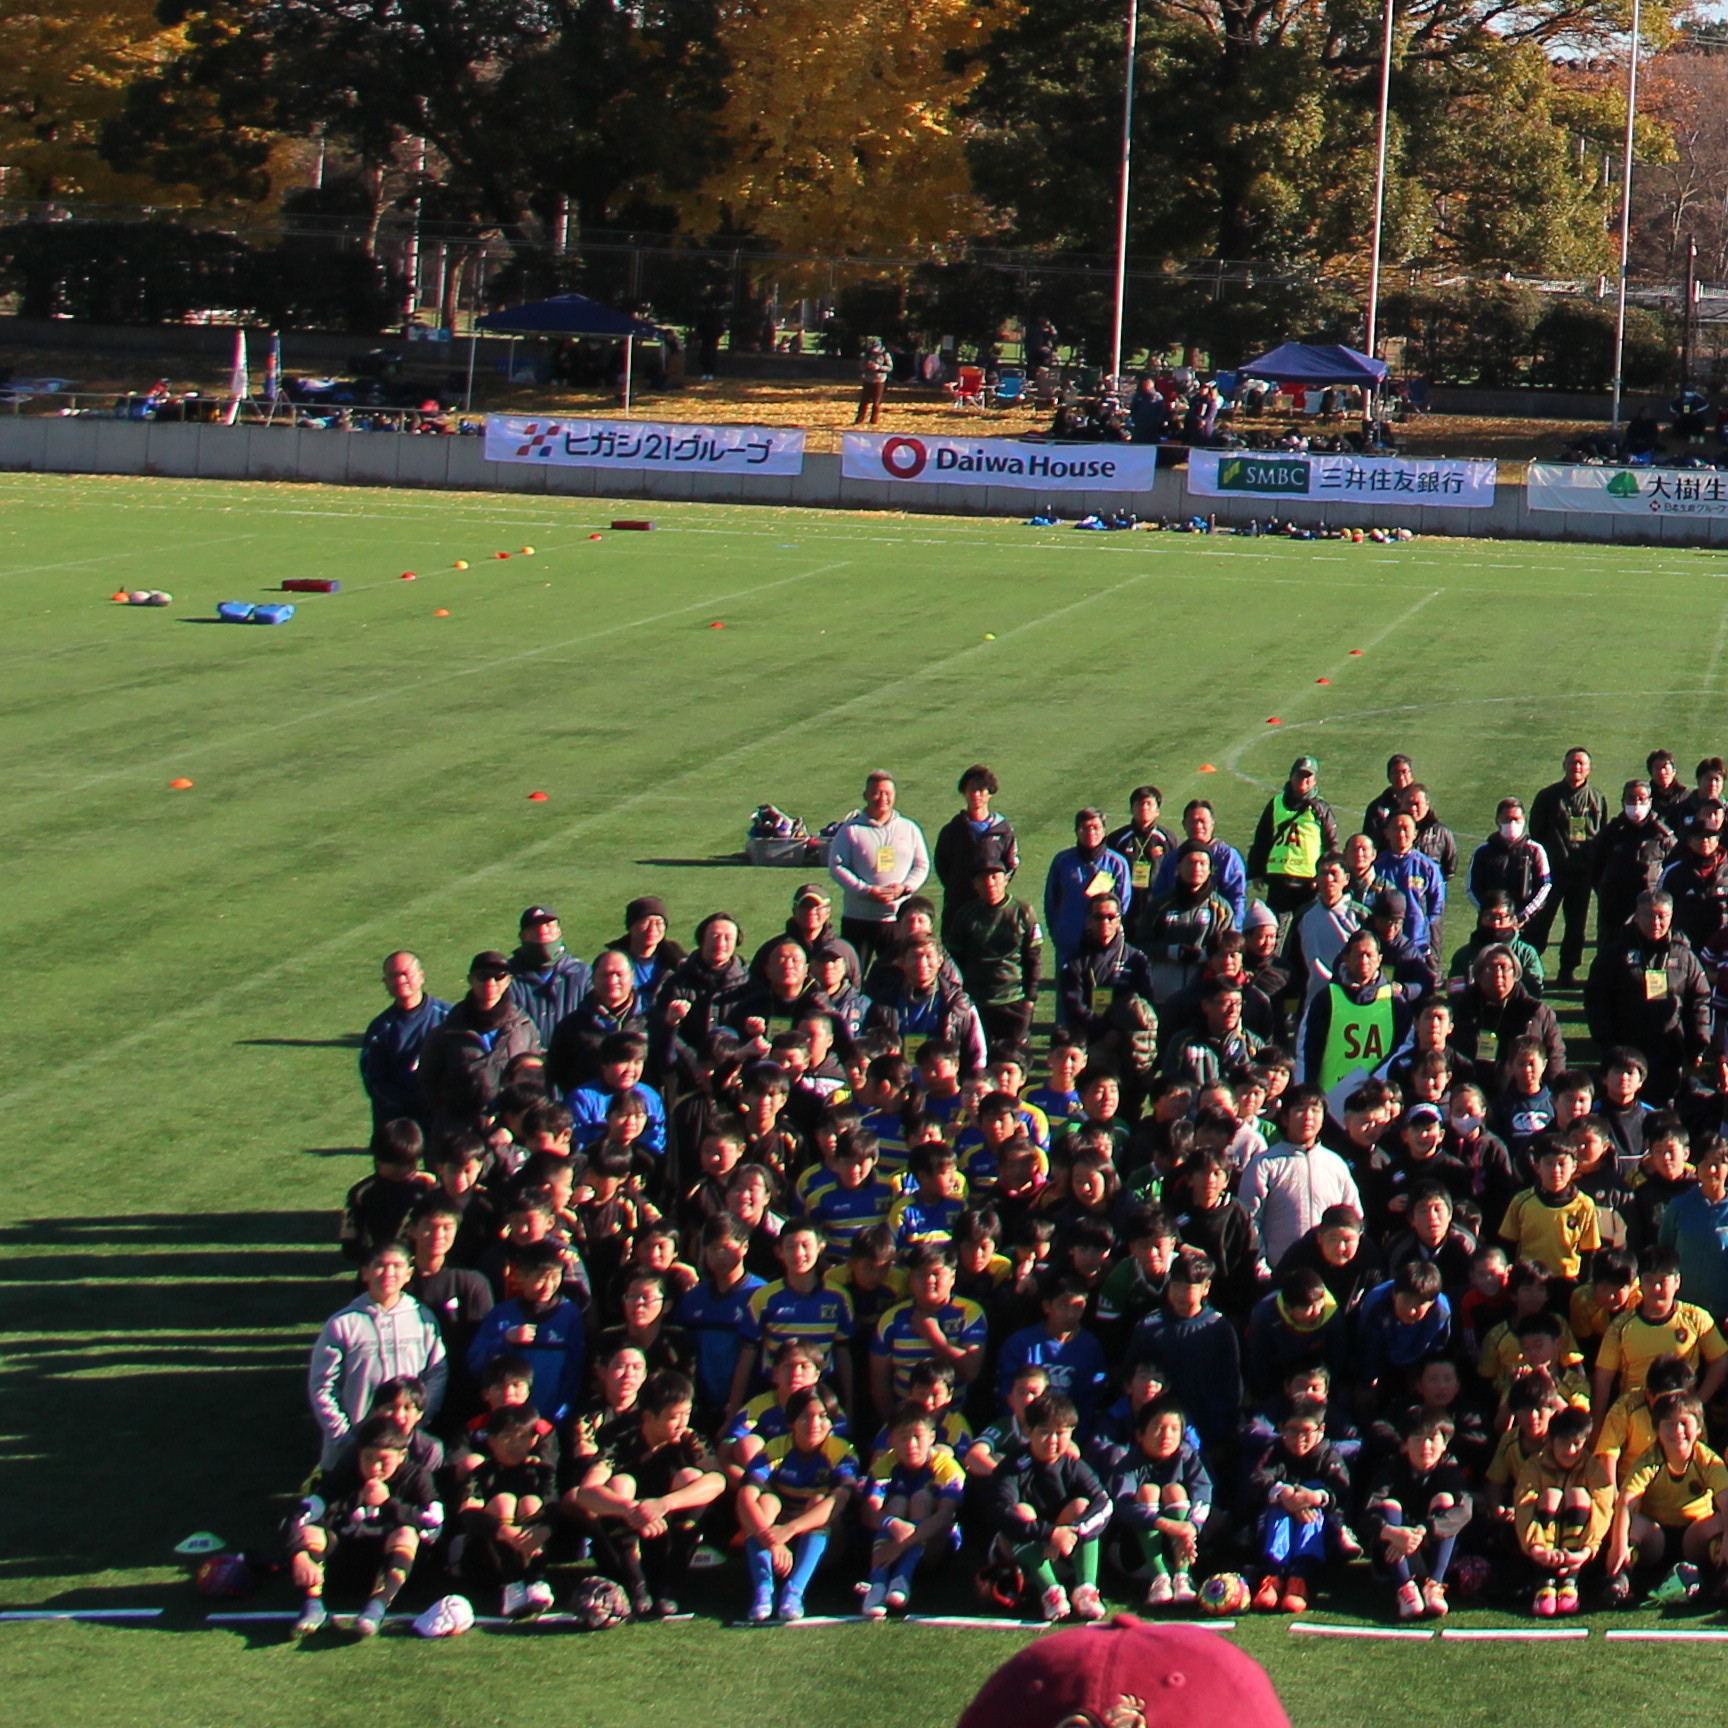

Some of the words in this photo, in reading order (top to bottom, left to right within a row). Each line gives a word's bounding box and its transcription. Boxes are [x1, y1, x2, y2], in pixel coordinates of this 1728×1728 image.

[565, 431, 773, 464] ヒガシ21グループ
[936, 448, 1024, 475] Daiwa
[1029, 455, 1116, 478] House
[1245, 466, 1306, 486] SMBC
[1319, 467, 1465, 495] 三井住友銀行
[1344, 1023, 1383, 1059] SA
